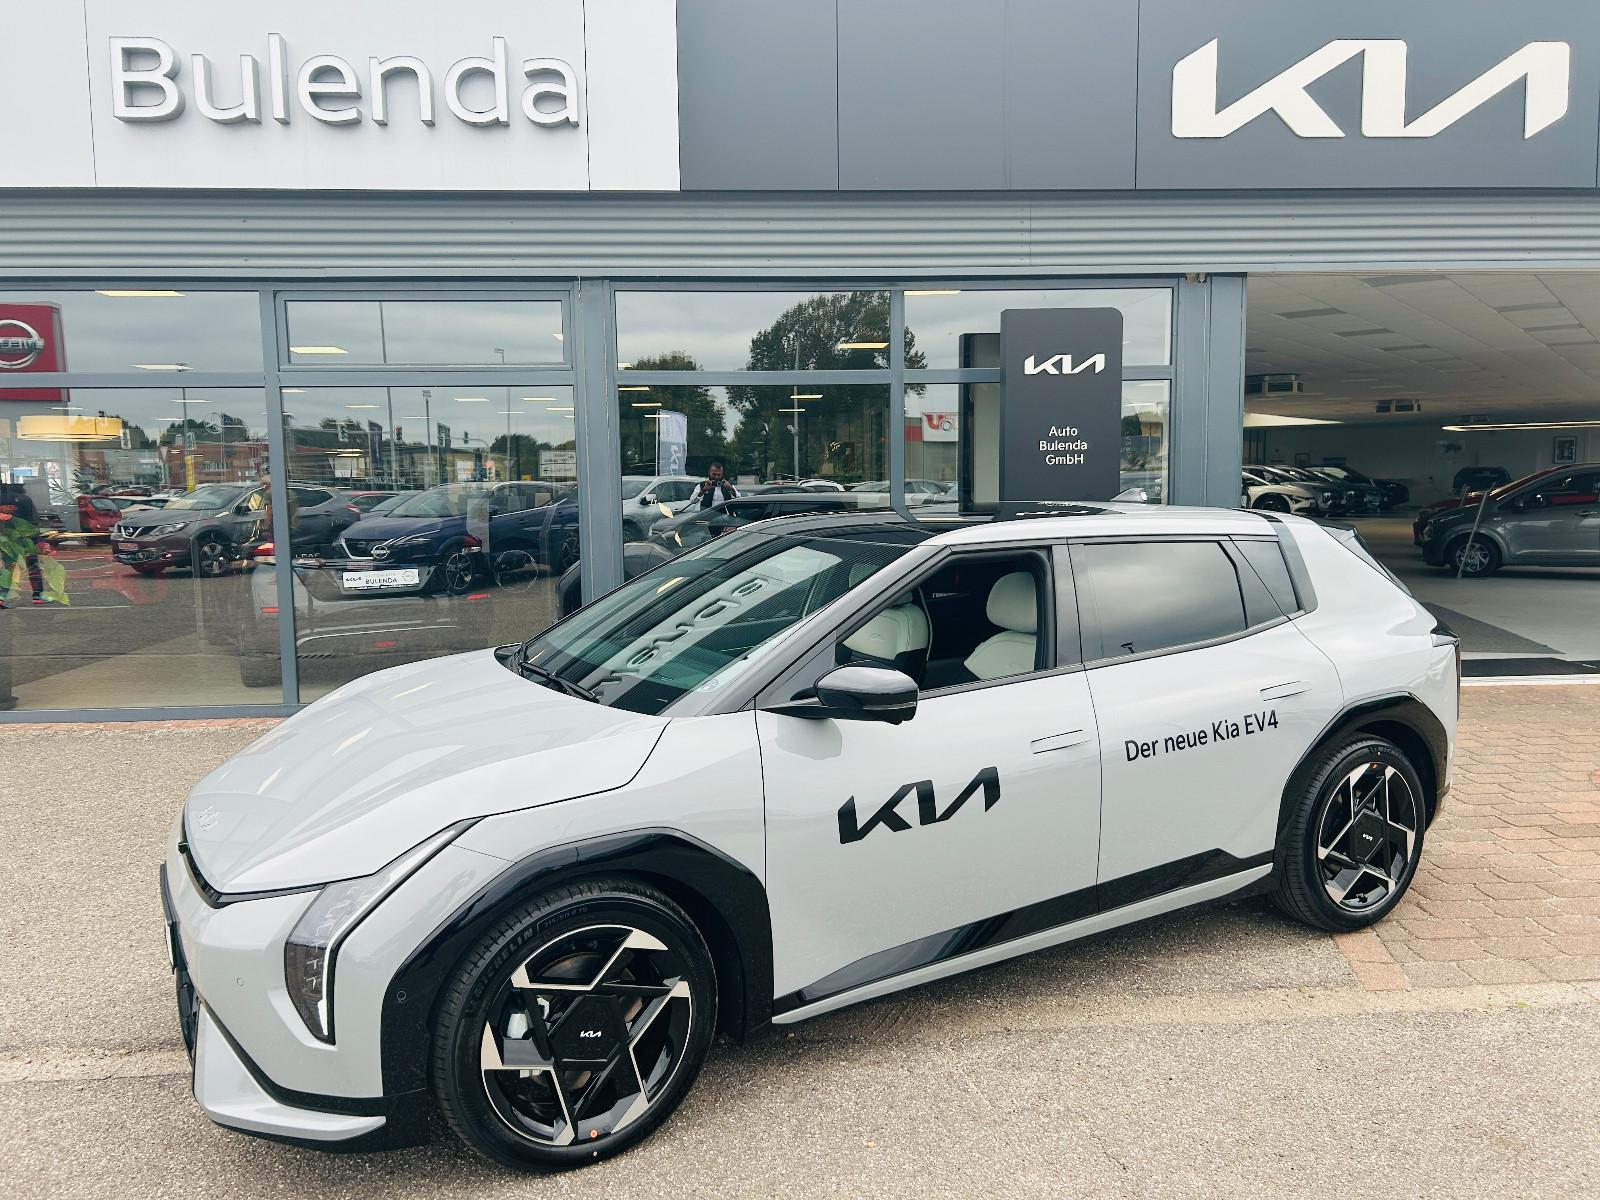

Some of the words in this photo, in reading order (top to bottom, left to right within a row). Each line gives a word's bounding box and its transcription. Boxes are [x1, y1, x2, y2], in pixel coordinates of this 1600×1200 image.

[108, 32, 581, 128] Bulenda
[1171, 37, 1571, 140] KIA
[1023, 353, 1106, 376] KIA
[1048, 425, 1078, 437] Auto
[1039, 439, 1088, 451] Bulenda
[1045, 453, 1085, 466] GmbH
[1124, 739, 1159, 762] Der
[1164, 728, 1208, 754] neue
[1211, 719, 1240, 743] Kia
[1243, 709, 1279, 735] EV4
[837, 765, 1001, 845] KIA
[579, 1030, 602, 1038] KIA
